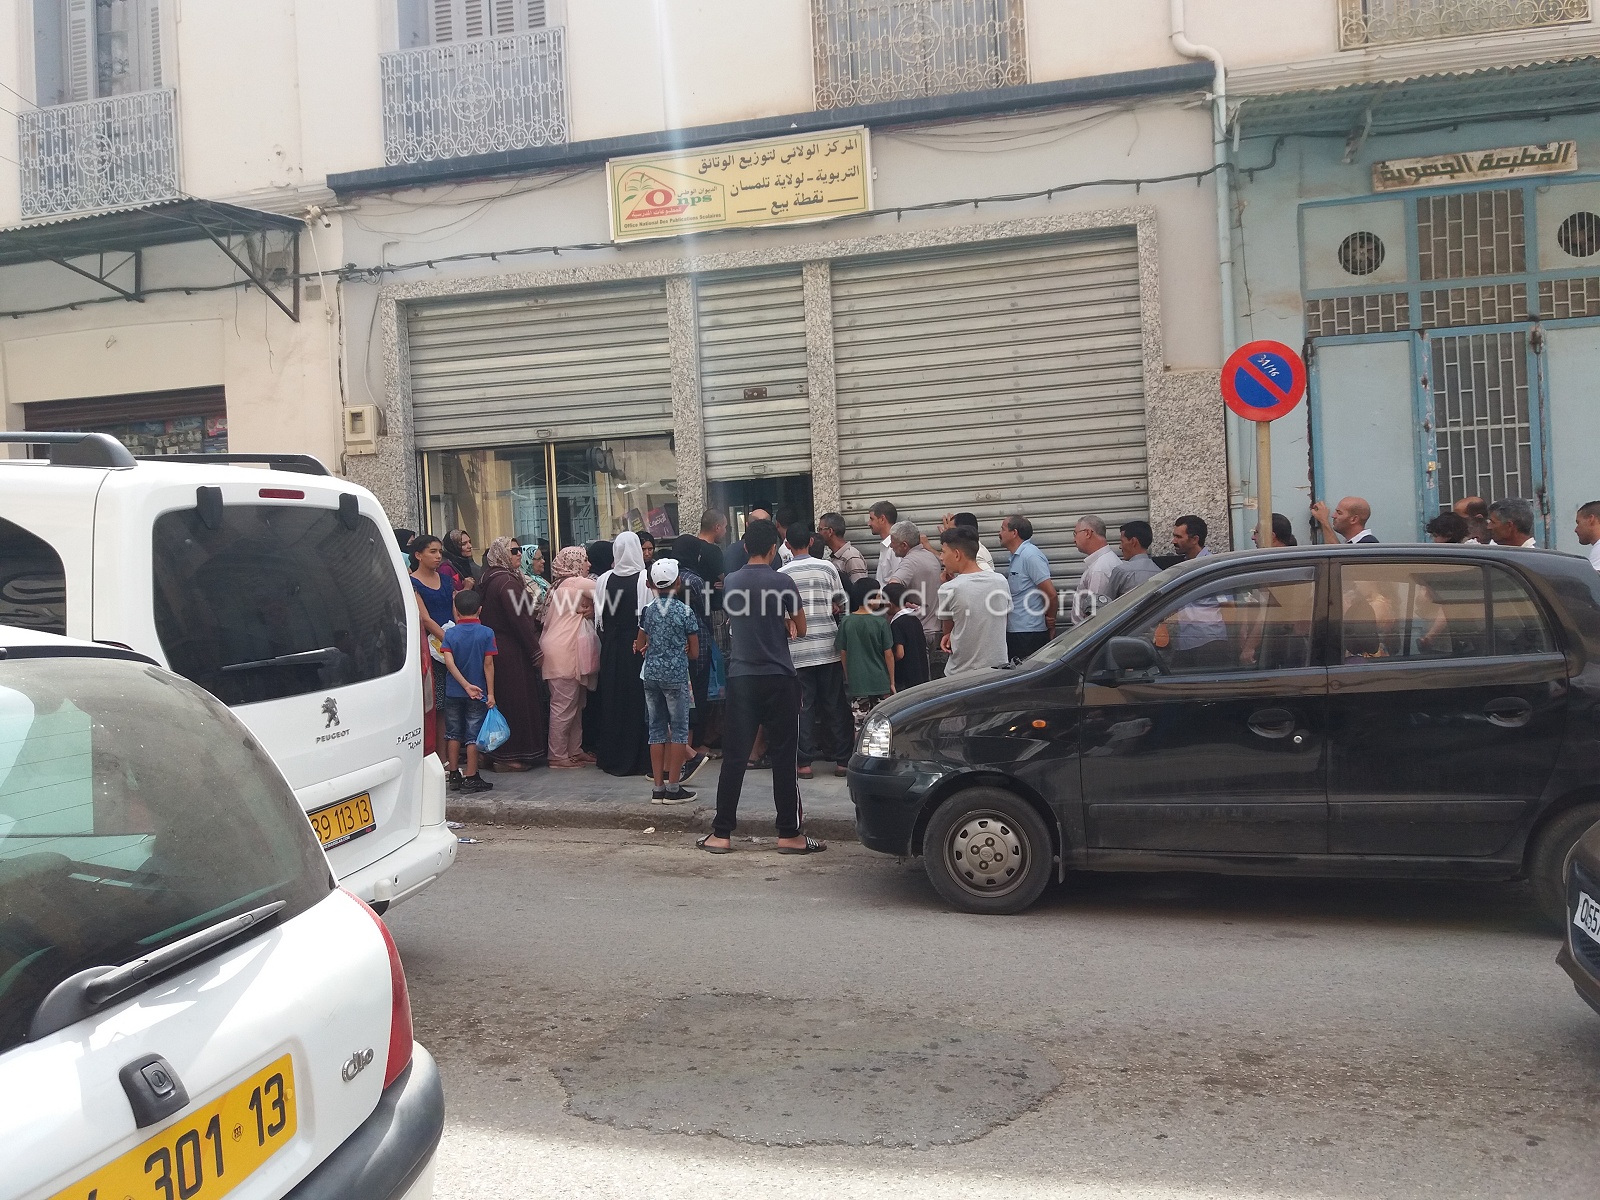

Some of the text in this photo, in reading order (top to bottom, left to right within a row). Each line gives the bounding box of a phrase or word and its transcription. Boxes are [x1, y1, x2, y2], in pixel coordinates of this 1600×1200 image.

[779, 143, 820, 165] الولائي
[823, 138, 858, 157] المركز
[738, 149, 776, 169] لتوزيع
[1478, 143, 1572, 173] المطبعة
[774, 172, 804, 189] لولاية
[815, 165, 860, 184] التربوية
[730, 177, 770, 197] تلمسان
[770, 189, 824, 215] نقطة بيع
[639, 219, 659, 227] National
[669, 215, 699, 223] Publications
[316, 729, 350, 744] PEUGEOT
[334, 805, 355, 834] 113
[355, 799, 370, 825] 13
[144, 1073, 287, 1200] 301 13
